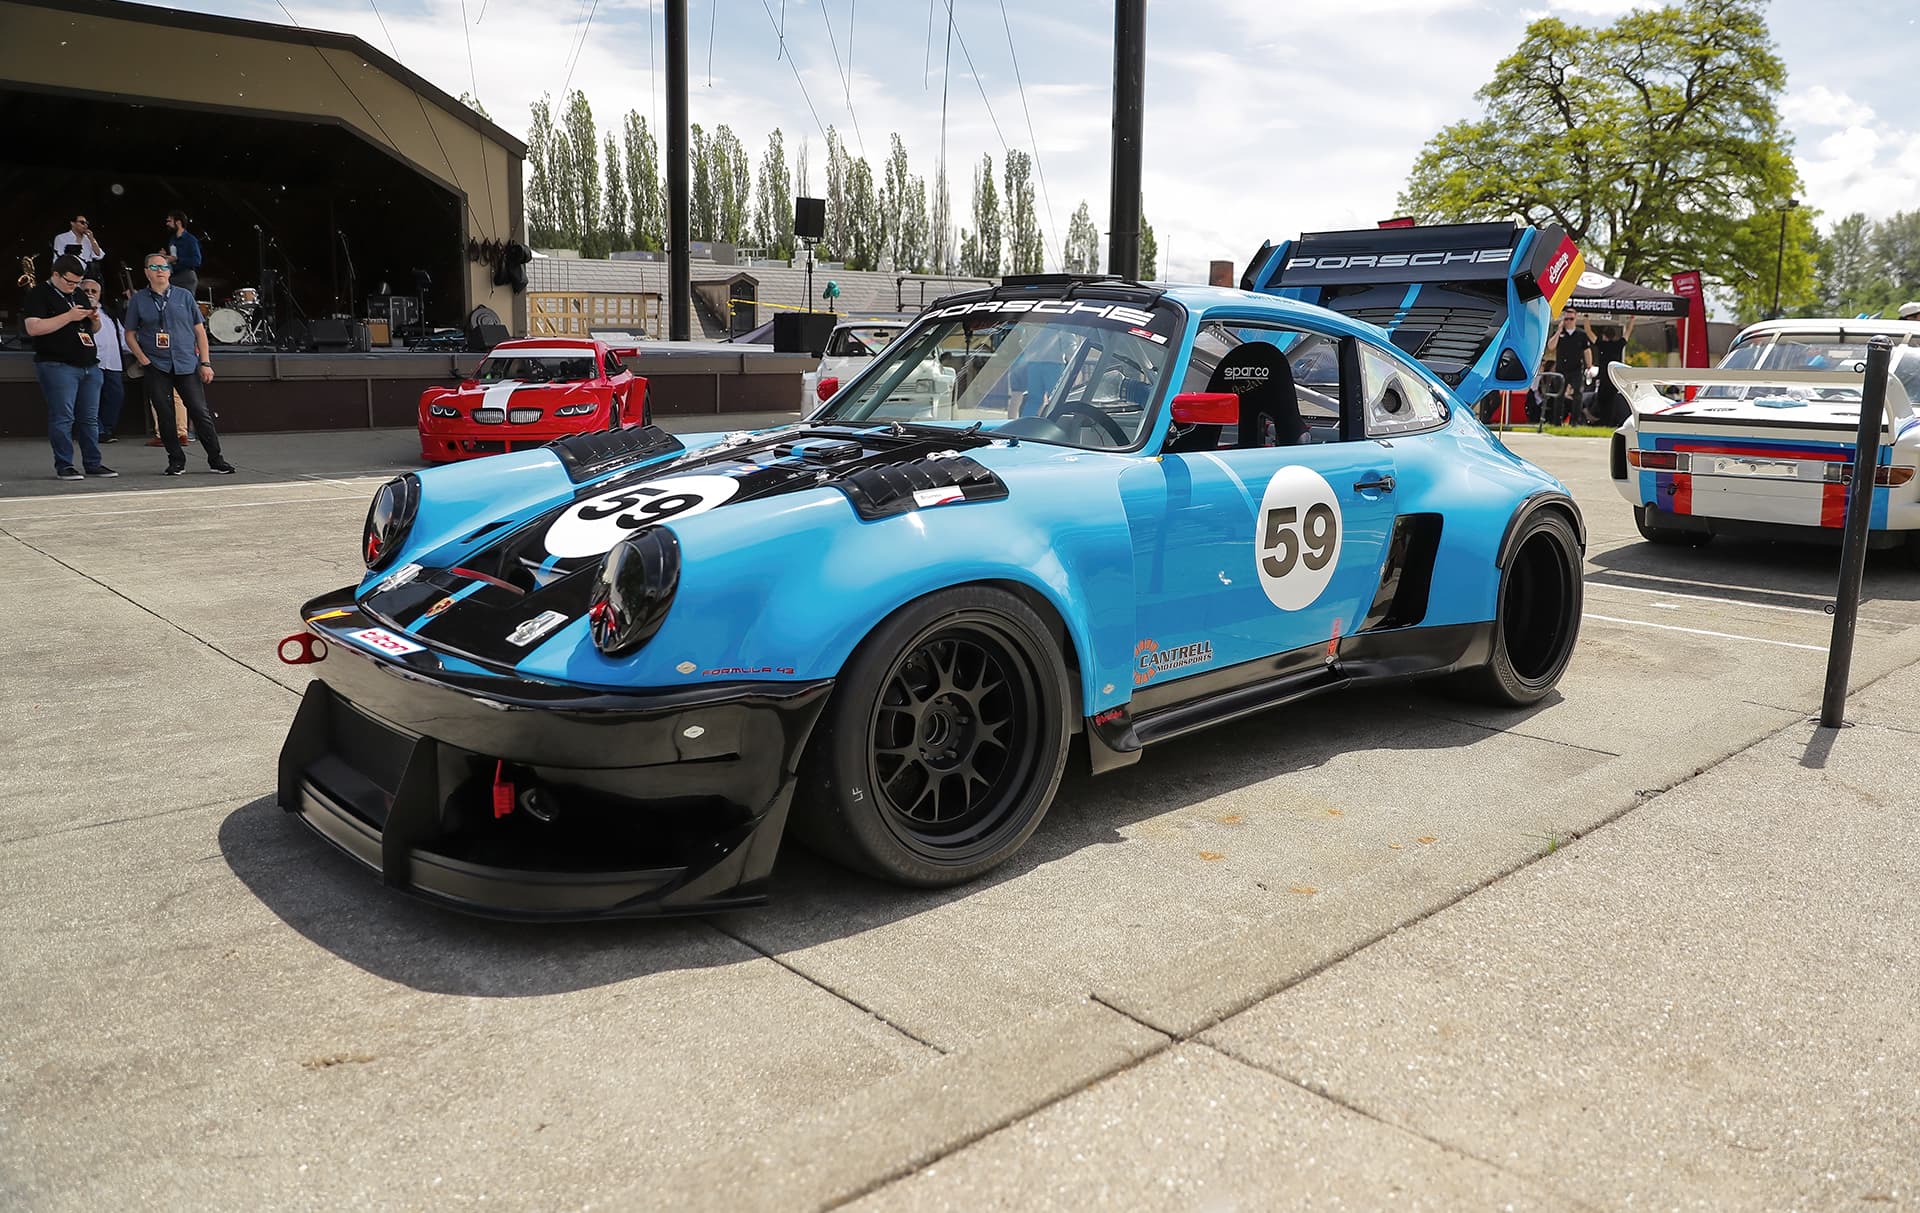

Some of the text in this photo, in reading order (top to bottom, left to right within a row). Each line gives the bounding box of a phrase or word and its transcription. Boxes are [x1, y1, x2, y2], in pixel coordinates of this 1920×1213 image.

[1285, 248, 1513, 270] PORSCHE
[919, 299, 1156, 327] PORSCHE
[1573, 299, 1615, 309] COLLECTIBLE
[1636, 300, 1675, 311] PERFECTED.
[1224, 367, 1269, 380] sparco
[577, 487, 704, 529] 59
[1262, 502, 1337, 578] 59
[1139, 641, 1212, 668] CANTRELL
[1156, 653, 1212, 671] MOTORSPORTS
[702, 667, 771, 676] FORMULA
[852, 787, 864, 802] LF
